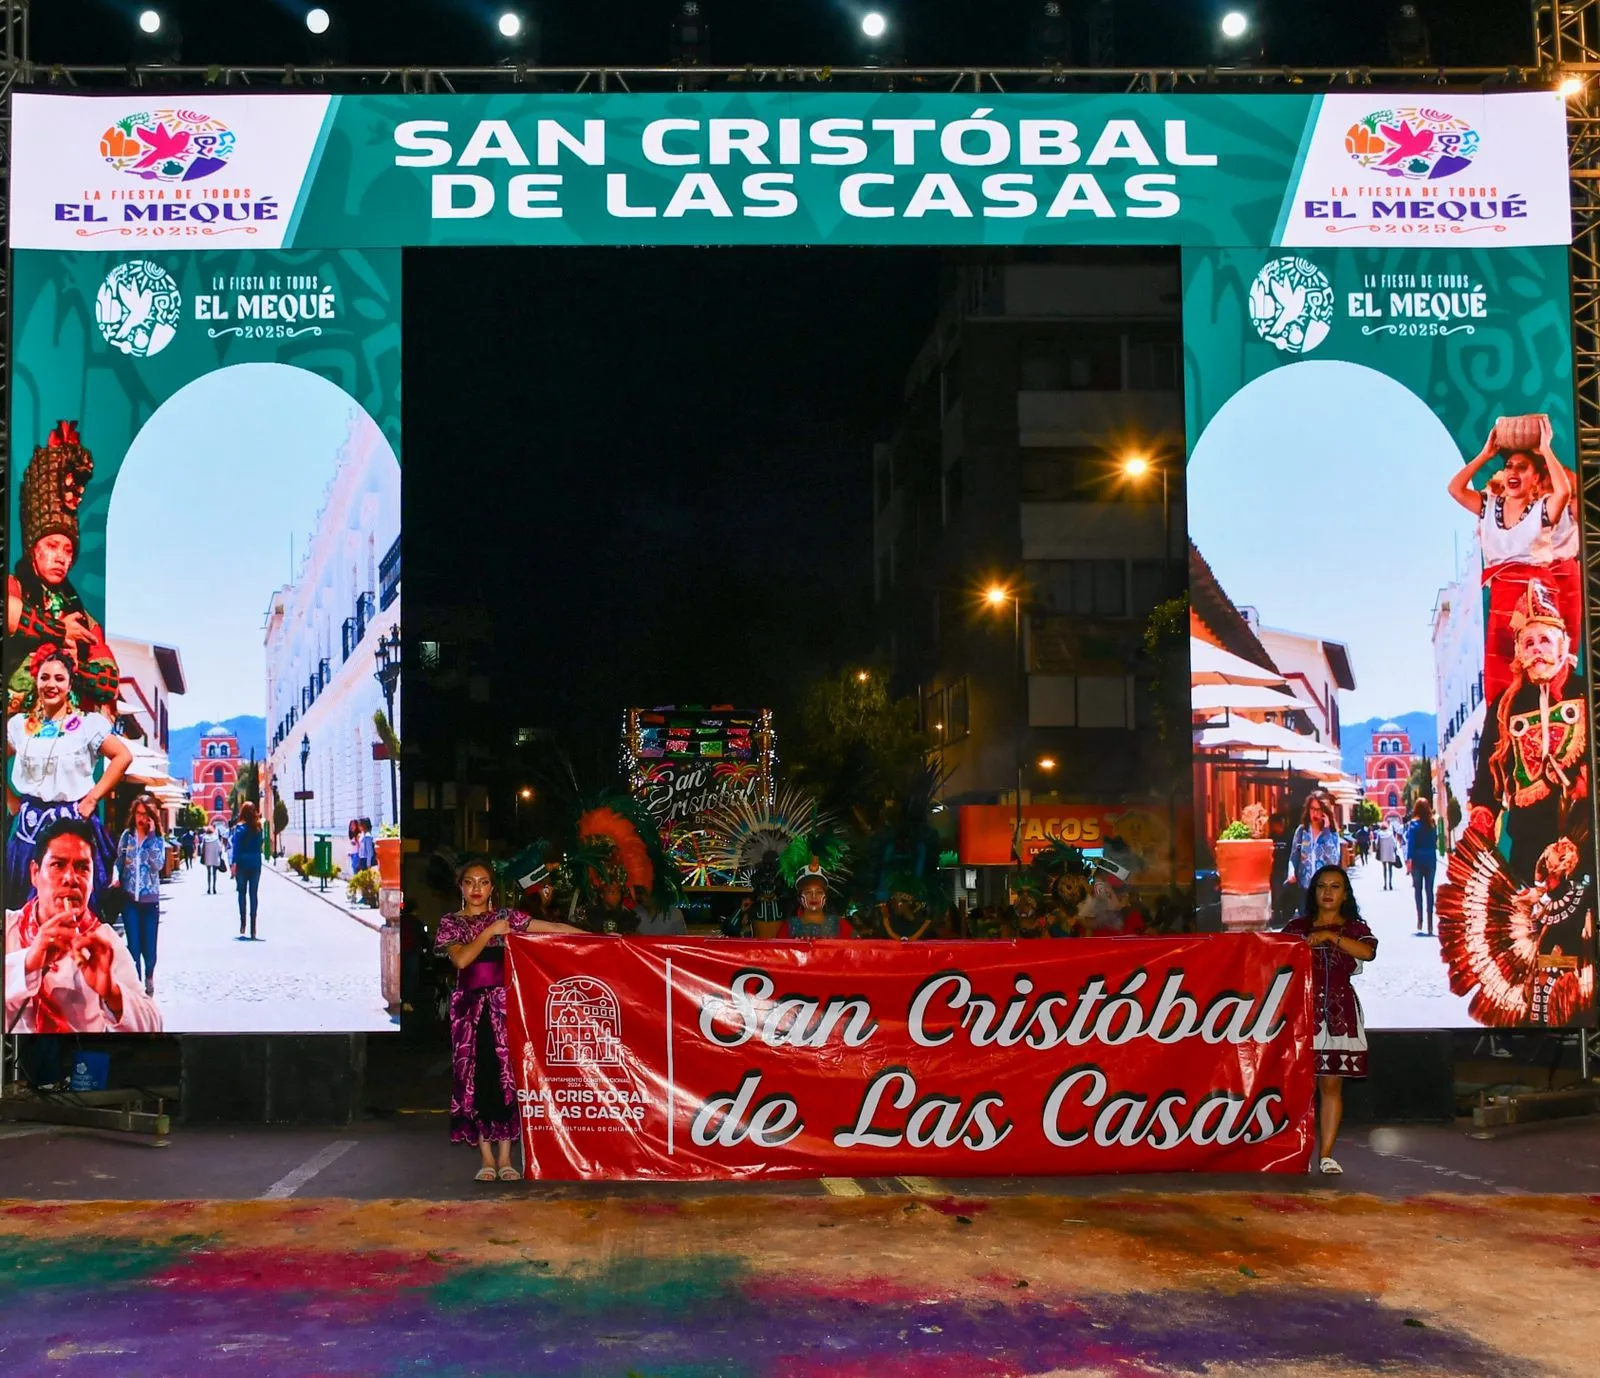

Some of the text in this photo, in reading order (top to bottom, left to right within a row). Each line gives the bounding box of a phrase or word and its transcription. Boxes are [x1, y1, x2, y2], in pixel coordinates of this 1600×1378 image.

[393, 107, 1219, 167] SAN CRISTÓBAL
[84, 188, 251, 200] LA FIESTA DE TODOS
[431, 172, 1181, 219] DE LAS CASAS
[1331, 186, 1498, 198] LA FIESTA DE TODOS
[54, 195, 279, 225] EL MEQUÉ
[1304, 193, 1528, 222] EL MEQUÉ
[135, 226, 198, 236] 2025
[1385, 223, 1447, 234] 2025
[212, 275, 319, 291] LA FIESTA DE TODOS
[1364, 274, 1469, 288] LA FIESTA DE TODOS
[194, 285, 335, 325] EL MEQUÉ
[1348, 284, 1488, 322] EL MEQUÉ
[244, 325, 285, 339] 2025
[1398, 323, 1439, 337] 2025
[649, 770, 707, 803] San
[1009, 817, 1101, 841] TACOS
[698, 966, 1294, 1050] San Cristóbal
[517, 1089, 551, 1102] SAN
[522, 1106, 645, 1119] DE LAS CASAS
[690, 1063, 1290, 1151] de Las Casas
